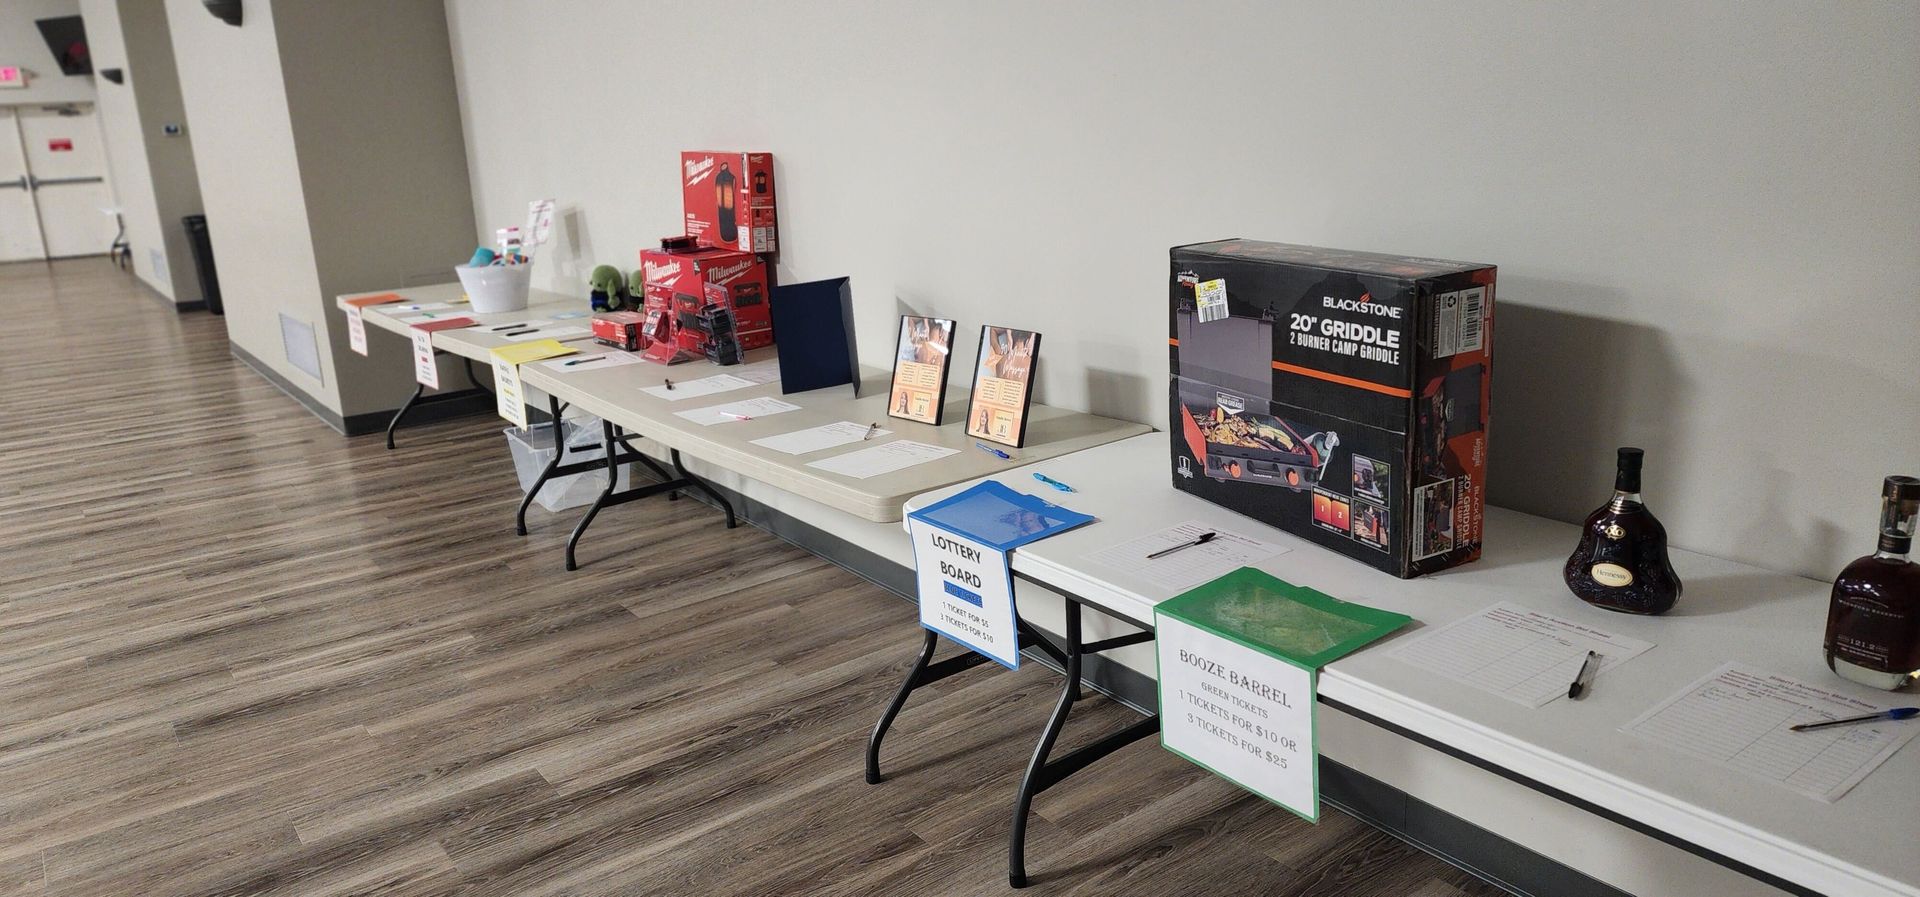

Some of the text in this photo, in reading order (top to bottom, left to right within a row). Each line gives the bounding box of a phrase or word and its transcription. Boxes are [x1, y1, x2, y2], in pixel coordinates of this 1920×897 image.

[644, 259, 680, 282] Milwaukee
[708, 260, 752, 282] Milwaukee
[1322, 296, 1401, 319] BLACKSTONE
[1290, 313, 1400, 349] 20" GRIDDLE
[1290, 331, 1400, 366] 2 BURNER CAMP GRIDDLE
[1462, 496, 1471, 547] GRIDDLE
[1472, 485, 1481, 545] BLACKSTONE
[931, 533, 981, 564] LOTTERY
[940, 560, 981, 588] BOARD
[1597, 569, 1627, 580] Hennessy
[945, 615, 968, 631] TICKETS
[969, 625, 981, 638] FOR
[983, 632, 993, 643] $10
[947, 603, 967, 619] TICKET
[968, 613, 980, 624] FOR
[981, 618, 989, 628] $5
[1180, 649, 1292, 709] BOOZE BARREL
[1201, 681, 1269, 719] GREEN TICKETS
[1179, 690, 1297, 752] 1 TICKETS FOR $10 OR
[1187, 712, 1288, 769] 3 TICKETS FOR $25
